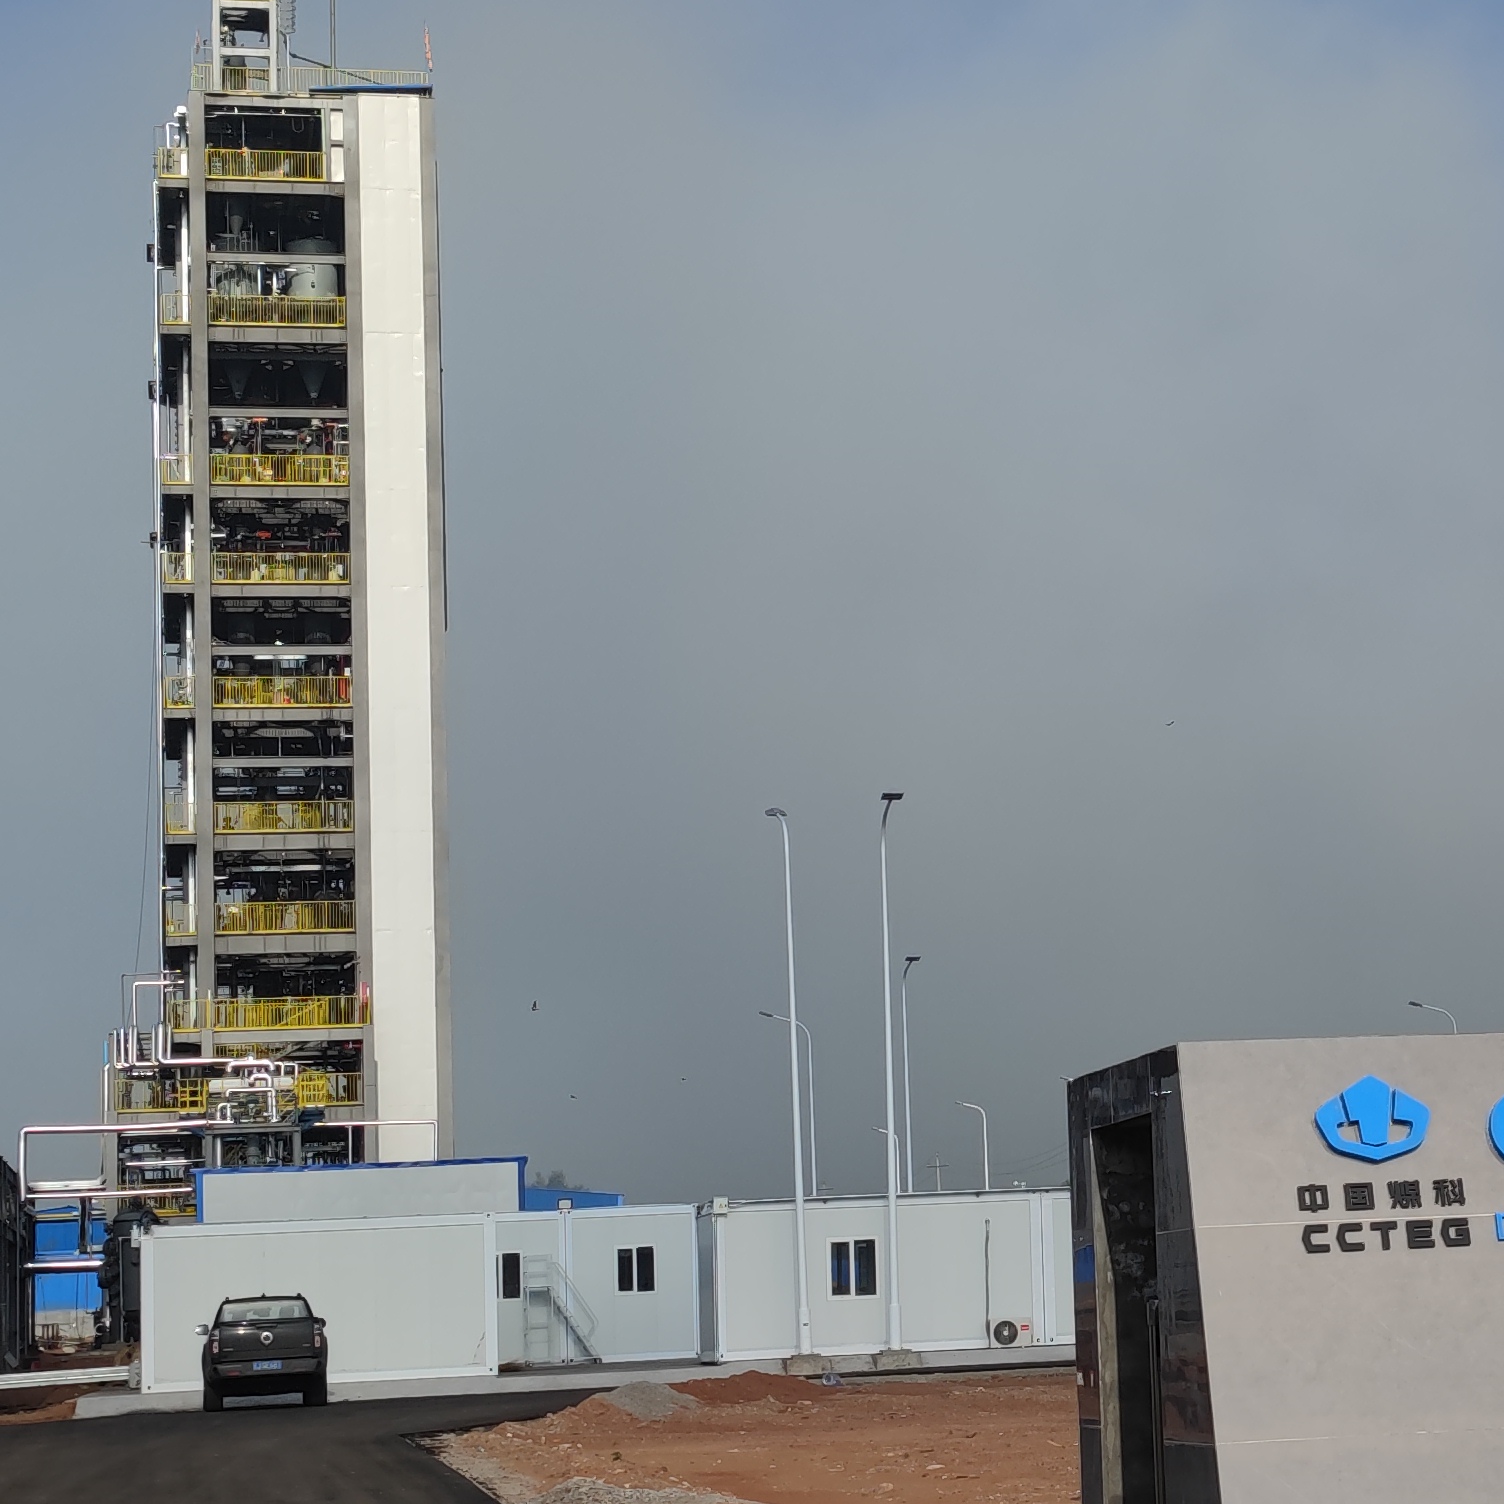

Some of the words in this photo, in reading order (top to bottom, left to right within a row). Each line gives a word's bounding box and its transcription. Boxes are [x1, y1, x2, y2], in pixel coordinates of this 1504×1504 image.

[1296, 1178, 1467, 1213] 中国煤科
[1302, 1217, 1472, 1254] CCTEG
